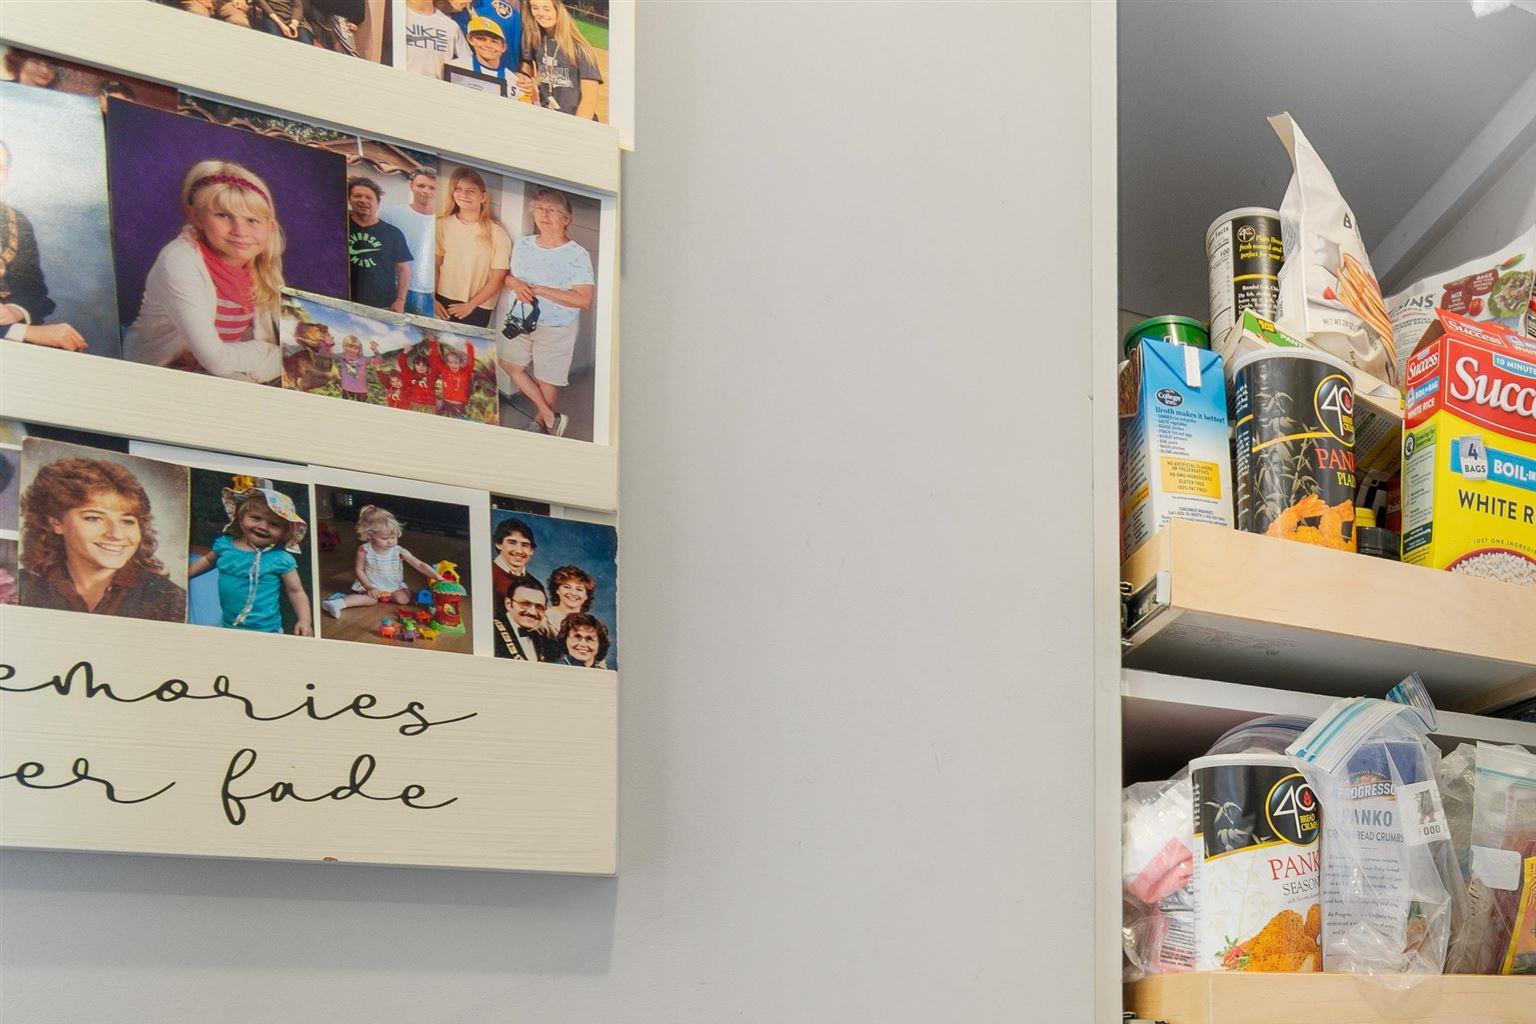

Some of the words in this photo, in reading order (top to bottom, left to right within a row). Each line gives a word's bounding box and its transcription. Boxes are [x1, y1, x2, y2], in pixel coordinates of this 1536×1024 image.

[1451, 290, 1463, 300] MIX
[1449, 320, 1503, 345] Success
[1408, 353, 1438, 380] Success
[1496, 357, 1505, 366] 10
[1158, 391, 1181, 402] College
[1423, 397, 1436, 411] RICE
[1155, 406, 1175, 415] Broth
[1176, 409, 1197, 418] makes
[1203, 414, 1225, 424] better!
[1468, 443, 1478, 460] 4
[1465, 464, 1486, 473] BAGS
[1458, 489, 1518, 520] WHITE
[221, 748, 458, 826] fade
[1376, 832, 1404, 842] CRUMBS
